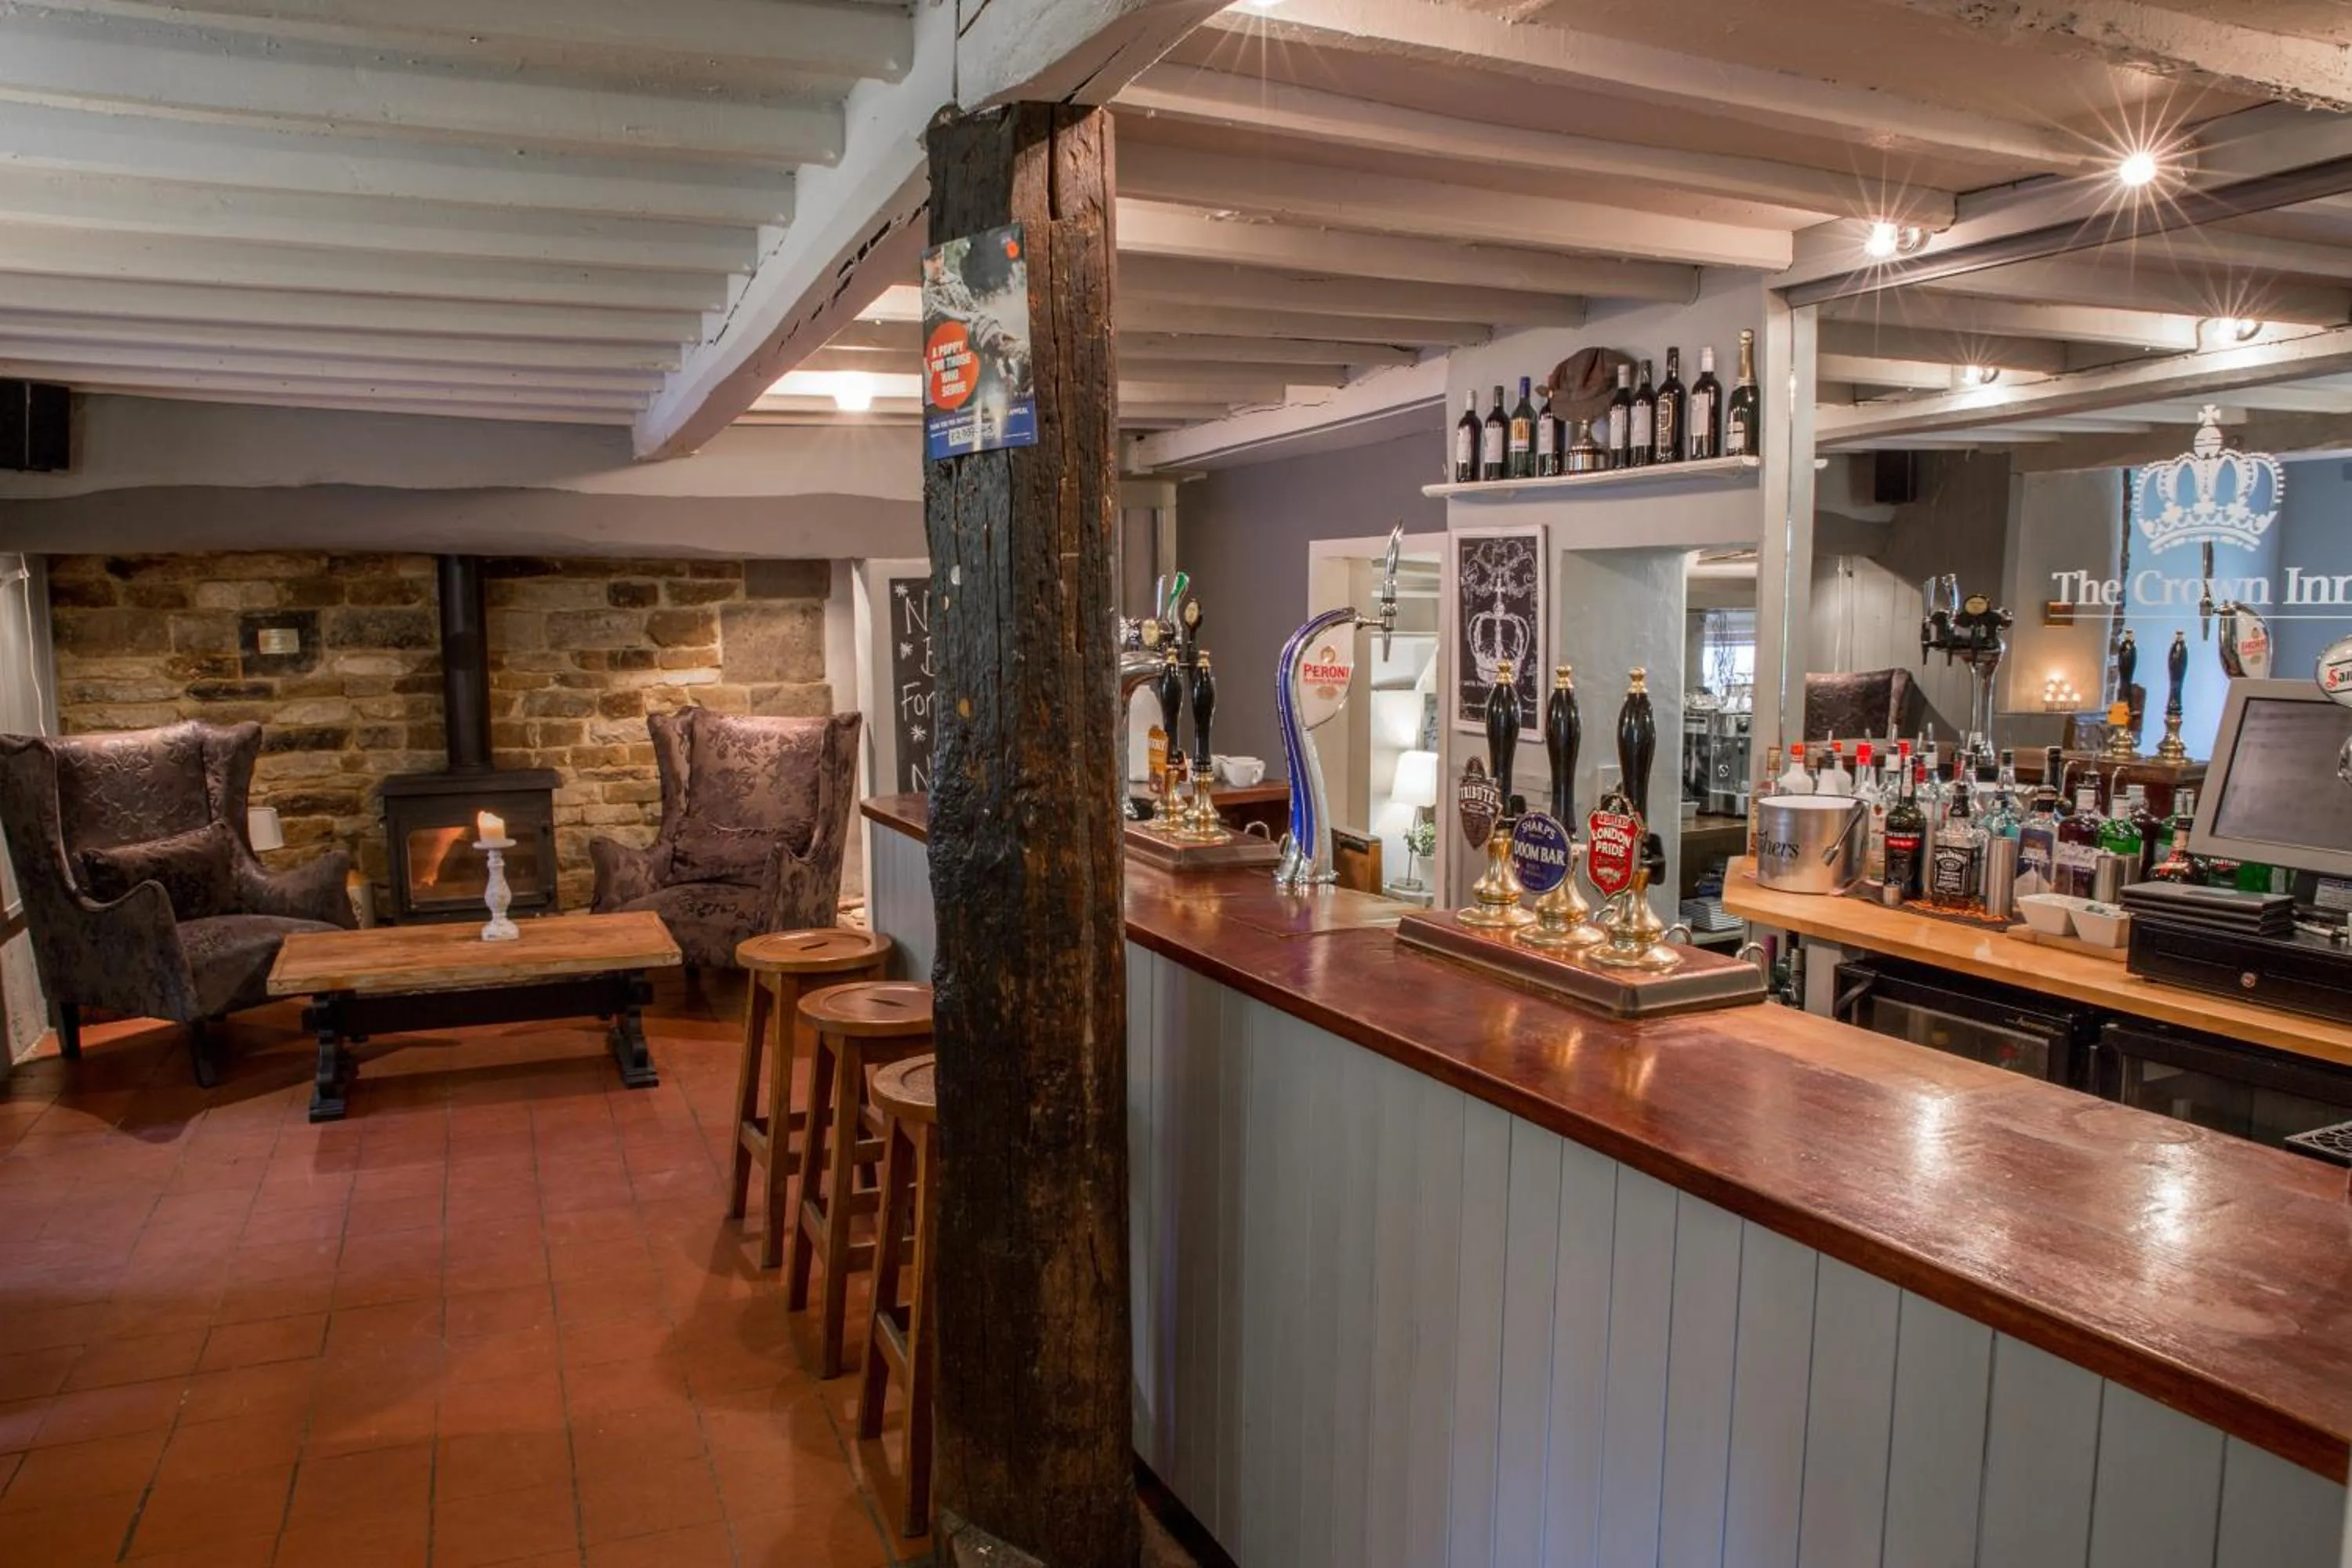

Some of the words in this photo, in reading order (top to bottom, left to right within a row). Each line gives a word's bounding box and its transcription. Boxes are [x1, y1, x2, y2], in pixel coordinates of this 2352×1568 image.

[2051, 570, 2122, 605] The
[2133, 570, 2273, 606] Crown
[1304, 664, 1349, 678] PERONI
[1459, 785, 1496, 805] TRIBUTE
[1522, 820, 1556, 840] SHARP'S
[1592, 826, 1632, 848] LONDON
[1514, 840, 1539, 862] DOOM
[1541, 847, 1566, 866] BAR
[1595, 840, 1626, 857] PRIDE
